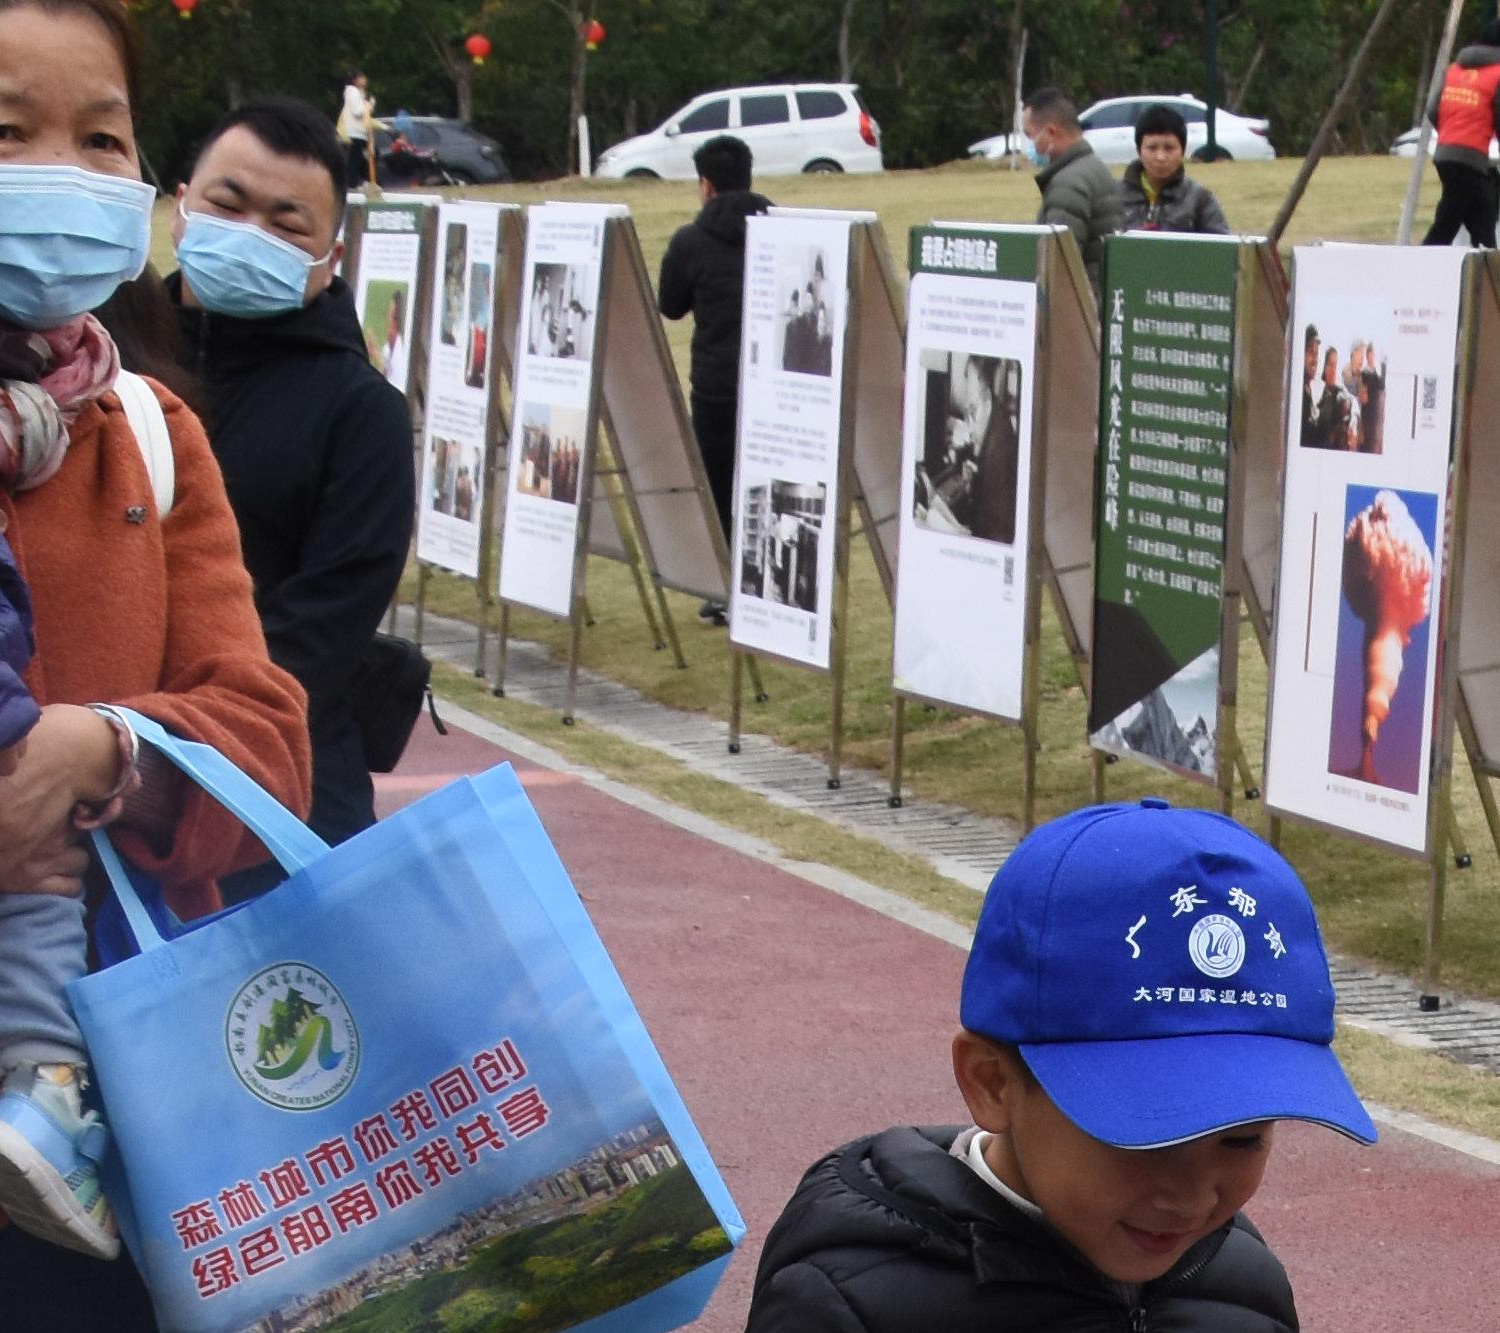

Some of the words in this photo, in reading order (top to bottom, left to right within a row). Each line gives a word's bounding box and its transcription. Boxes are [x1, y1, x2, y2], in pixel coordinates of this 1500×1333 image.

[1133, 987, 1287, 1008] 大河国家湿地公园
[171, 1039, 527, 1250] 森林城市你我同创
[192, 1086, 550, 1298] 绿色郁南你我共享
